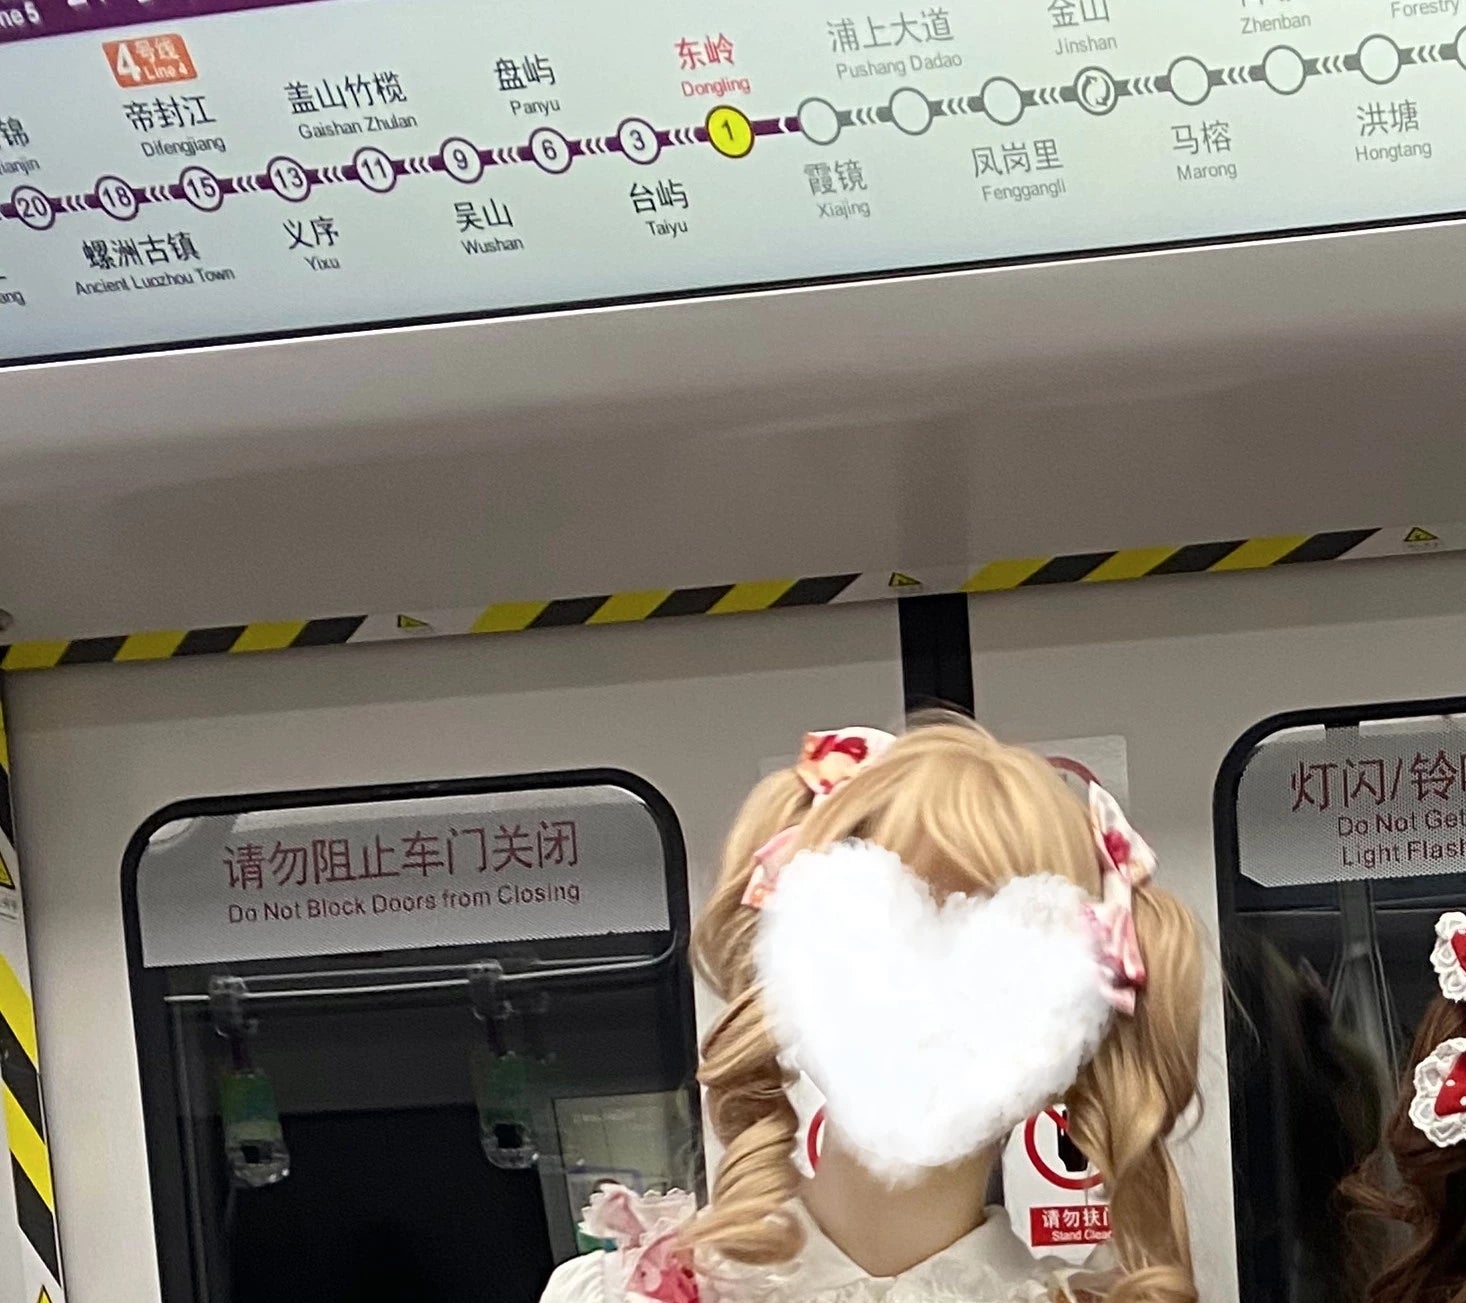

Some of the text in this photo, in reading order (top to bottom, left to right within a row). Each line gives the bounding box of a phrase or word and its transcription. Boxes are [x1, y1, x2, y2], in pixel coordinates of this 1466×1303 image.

[1047, 0, 1111, 29] 金山
[1391, 0, 1460, 17] Forestry
[826, 7, 955, 53] 浦上大道
[1240, 12, 1312, 35] Zhenban
[675, 33, 735, 71] 东岭
[1055, 34, 1118, 56] Jinshan
[117, 43, 141, 82] 4
[143, 61, 188, 80] Line 4
[494, 54, 556, 92] 盘屿
[836, 53, 963, 80] Pushang Dadao
[284, 70, 407, 115] 盖山竹榄
[681, 76, 751, 98] Dongling
[122, 95, 216, 133] 帝封江
[510, 99, 561, 118] Panyu
[1357, 100, 1420, 137] 洪塘
[298, 113, 418, 140] Gaishan Zhulan
[721, 120, 735, 141] 1
[1170, 120, 1233, 156] 马榕
[140, 136, 226, 158] Difengjiang
[541, 139, 557, 160] 6
[632, 130, 646, 151] 3
[1354, 141, 1432, 163] Hongtang
[361, 157, 384, 179] 11
[452, 149, 468, 170] 9
[971, 138, 1064, 178] 凤岗里
[275, 166, 304, 189] 13
[803, 159, 869, 196] 霞镜
[1177, 163, 1238, 182] Marong
[102, 186, 132, 207] 18
[186, 176, 217, 198] 15
[630, 179, 689, 214] 台屿
[981, 178, 1067, 203] Fenggangli
[21, 198, 48, 218] 20
[454, 198, 514, 233] 吴山
[818, 201, 871, 221] Xiajing
[283, 216, 339, 250] 义序
[646, 220, 689, 238] Taiyu
[82, 231, 201, 270] 螺洲古镇
[460, 237, 525, 255] Wushan
[303, 255, 341, 272] Yixu
[75, 267, 236, 296] Ancient Luozhou Town
[1338, 814, 1369, 837] Do
[1376, 812, 1416, 834] Not
[1424, 807, 1465, 830] Get
[223, 820, 580, 891] 请勿阻止车门关闭
[1342, 843, 1401, 869] Light
[227, 881, 581, 925] Do Not Block Doors from Closing
[1051, 1229, 1082, 1242] Stand
